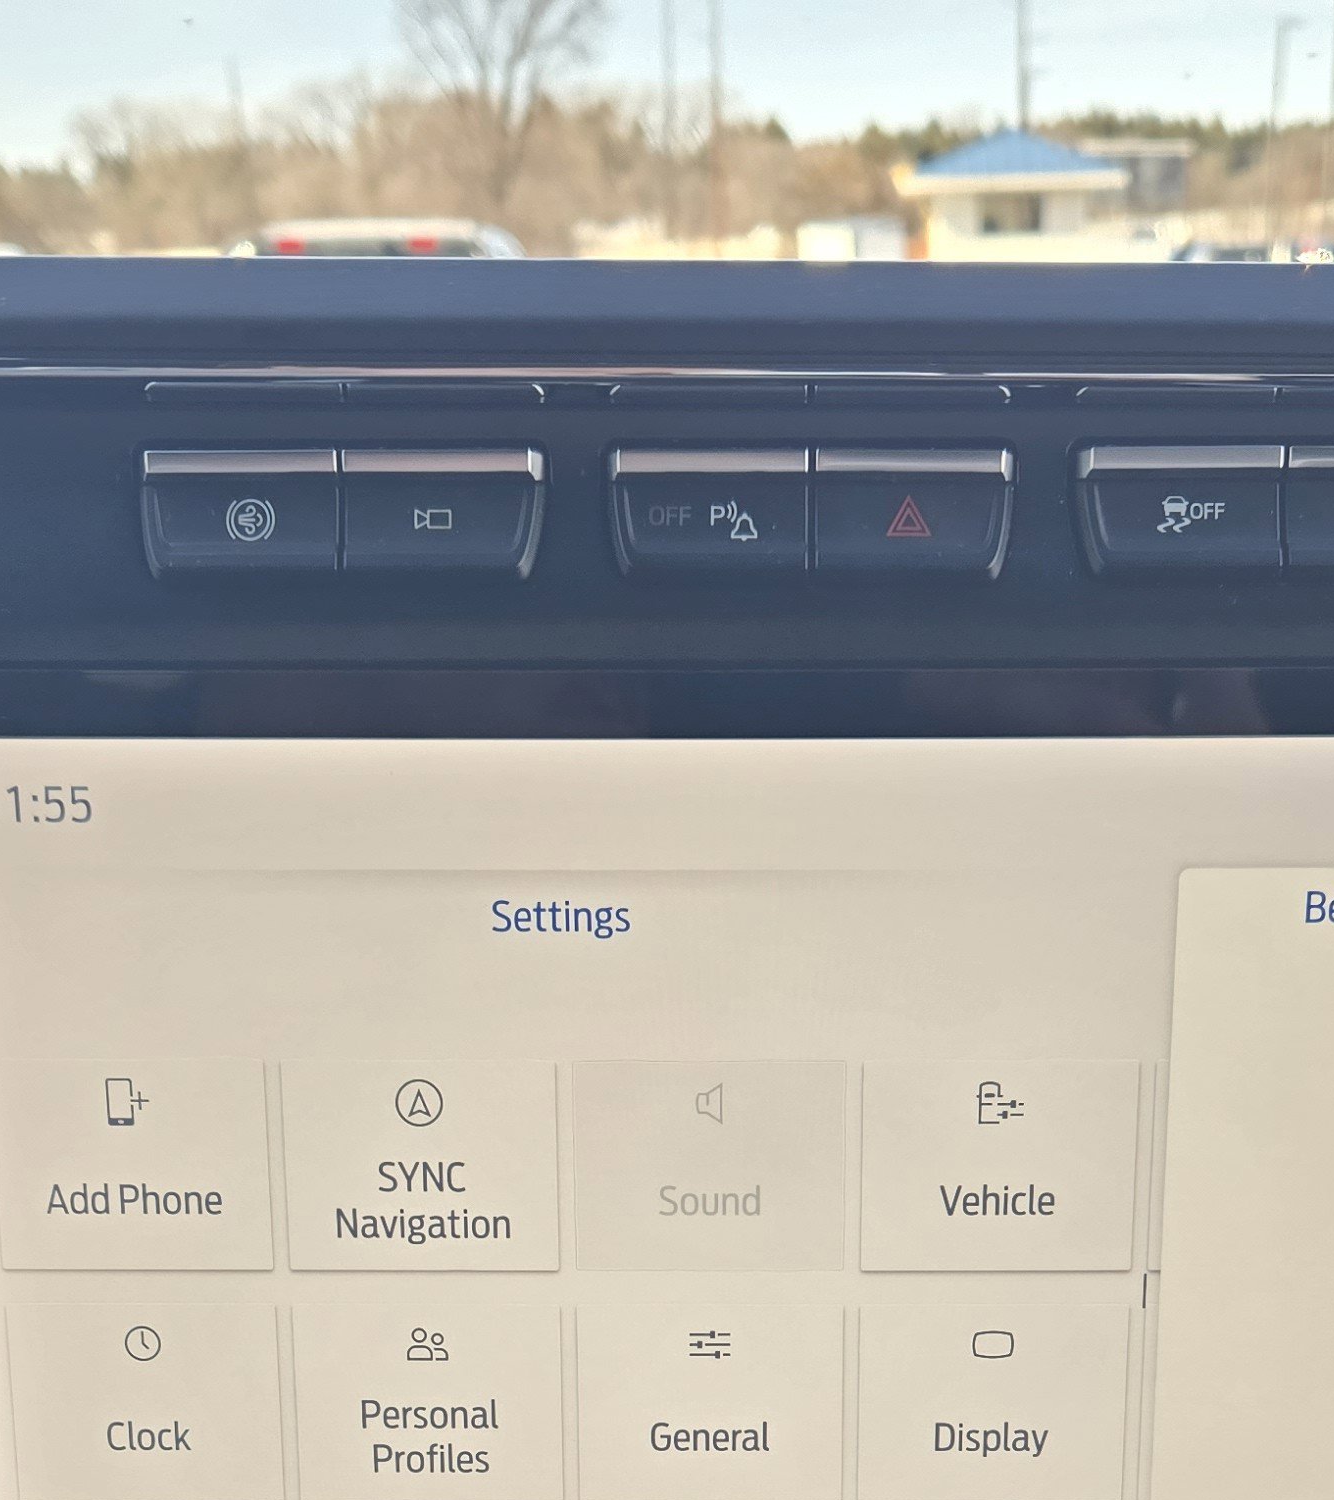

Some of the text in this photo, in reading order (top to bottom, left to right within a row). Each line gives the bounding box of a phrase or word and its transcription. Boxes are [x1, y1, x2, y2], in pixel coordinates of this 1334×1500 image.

[648, 505, 692, 527] OFF
[1189, 502, 1226, 520] OFF
[492, 899, 631, 940] Settings
[378, 1161, 466, 1193] SYNC
[46, 1182, 223, 1216] Add Phone
[658, 1184, 761, 1217] Sound
[939, 1183, 1055, 1217] Vehicle
[336, 1207, 511, 1245] Navigation
[361, 1398, 499, 1430] Personal
[106, 1420, 192, 1451] Clock
[650, 1421, 770, 1452] General
[934, 1421, 1049, 1458] Display
[372, 1442, 490, 1474] Profiles
